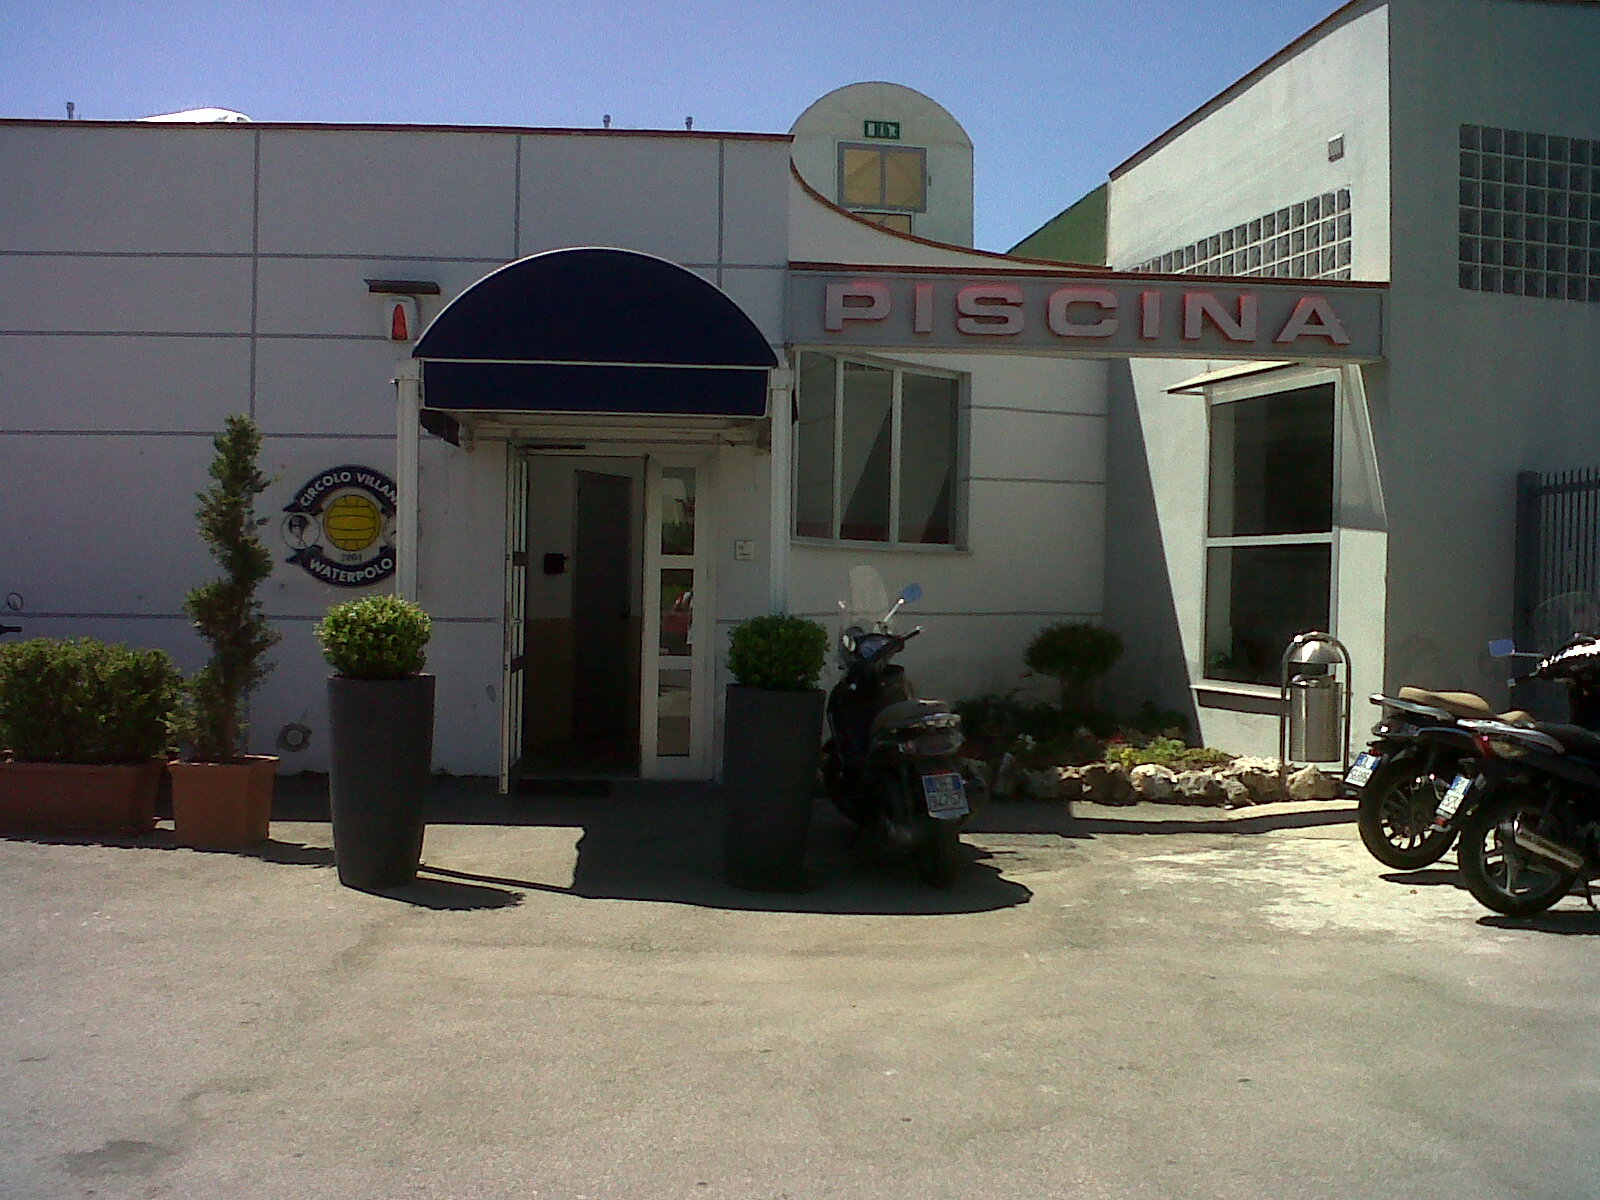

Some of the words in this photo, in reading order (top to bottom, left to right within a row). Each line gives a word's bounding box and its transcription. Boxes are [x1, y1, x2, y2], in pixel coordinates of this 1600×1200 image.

[823, 280, 1351, 345] PISCINA
[300, 471, 352, 507] CIRCOLO
[309, 558, 394, 583] WATERPOLO
